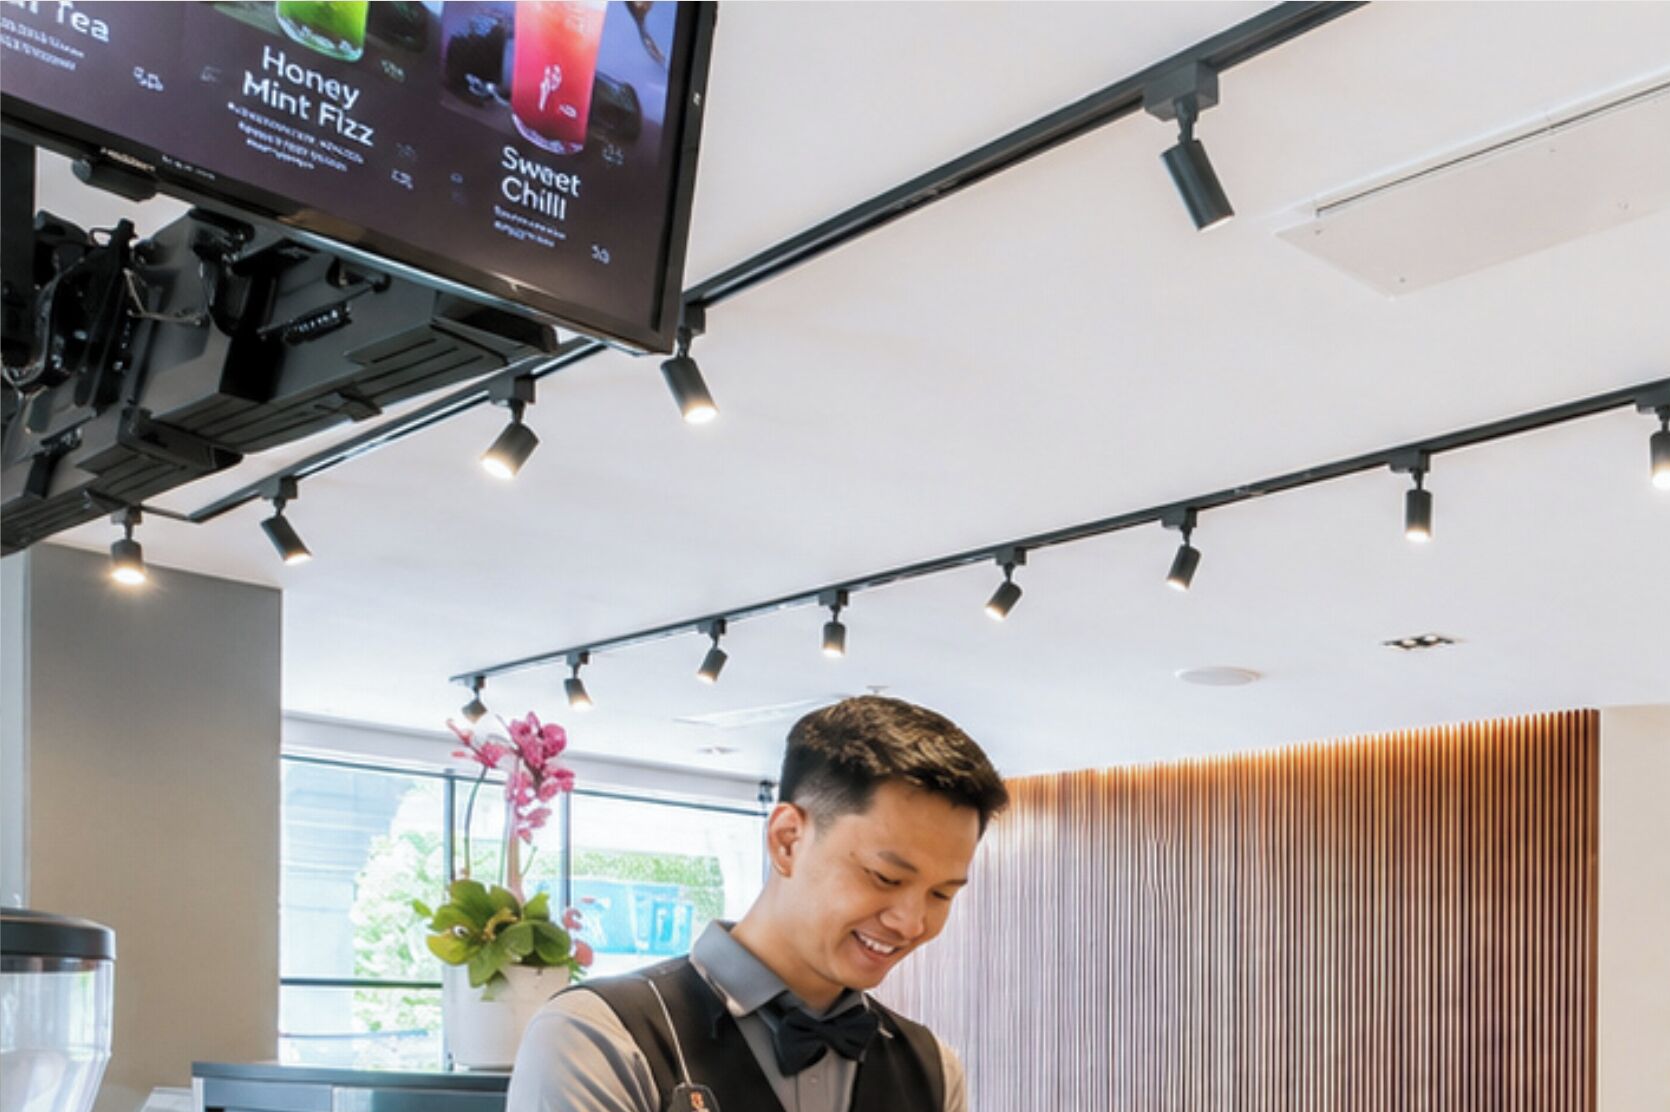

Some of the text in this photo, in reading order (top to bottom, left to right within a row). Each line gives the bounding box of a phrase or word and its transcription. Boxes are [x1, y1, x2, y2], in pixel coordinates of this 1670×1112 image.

[56, 1, 110, 43] Tea
[261, 44, 360, 111] Honey
[242, 69, 311, 121] Mint
[318, 101, 374, 148] Fizz
[501, 145, 581, 198] Sweet
